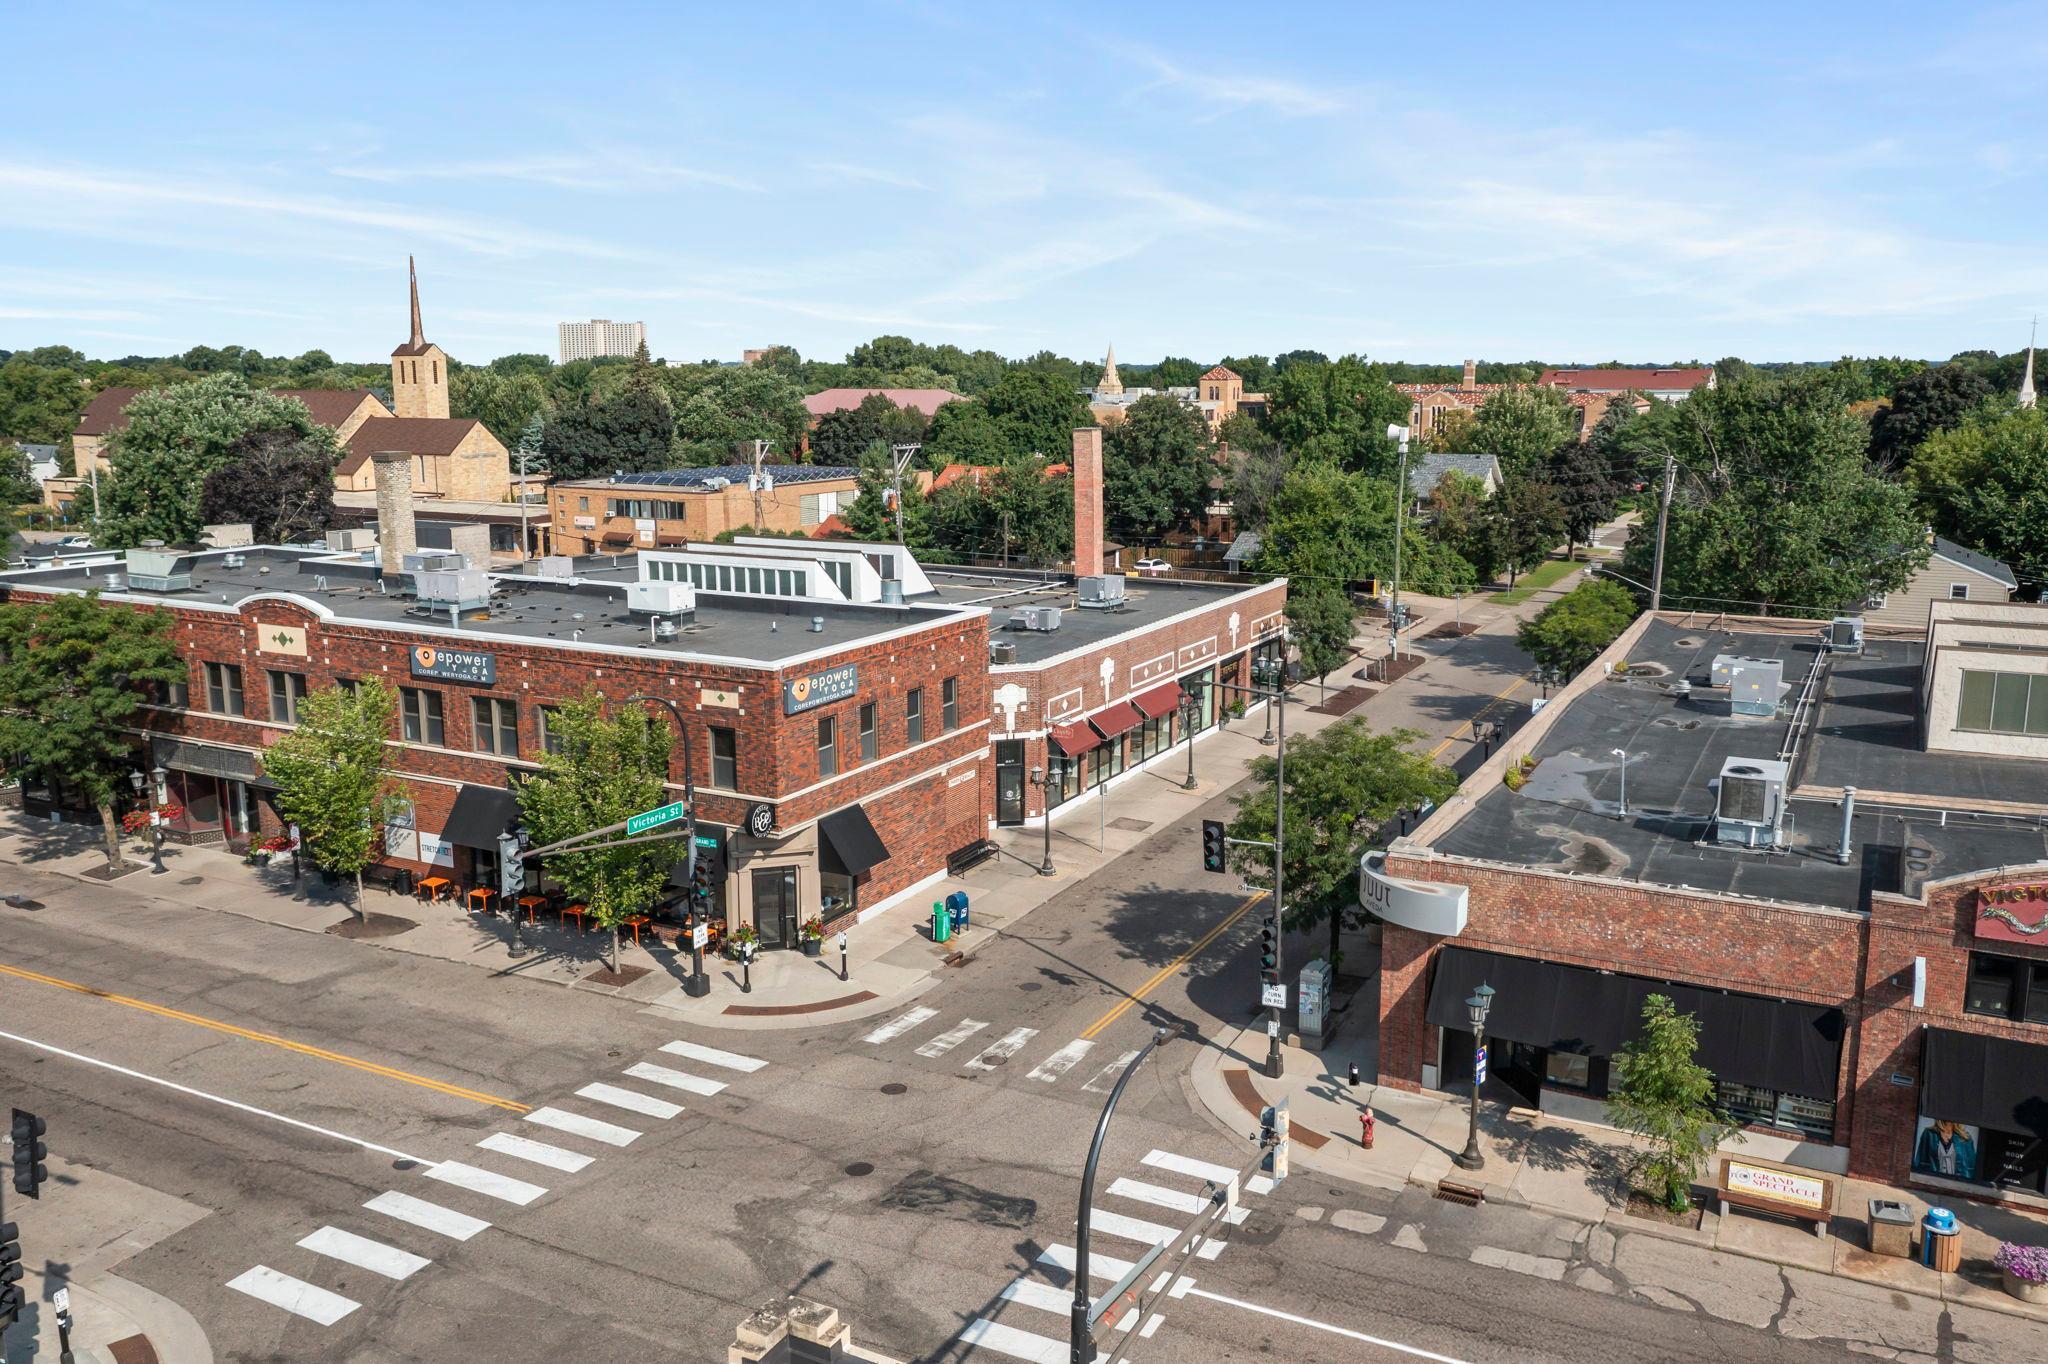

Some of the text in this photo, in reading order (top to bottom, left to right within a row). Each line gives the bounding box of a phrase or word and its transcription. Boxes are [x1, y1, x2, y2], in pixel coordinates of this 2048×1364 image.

[452, 664, 488, 675] YGA
[824, 679, 854, 695] YOGA
[632, 806, 679, 829] Victoria St
[1268, 991, 1282, 999] TURN
[2008, 1139, 2025, 1147] SKIN
[2005, 1151, 2025, 1160] BODY
[2003, 1163, 2024, 1172] NAILS
[1753, 1172, 1794, 1186] GRAND
[1752, 1180, 1818, 1198] SPECTACLE
